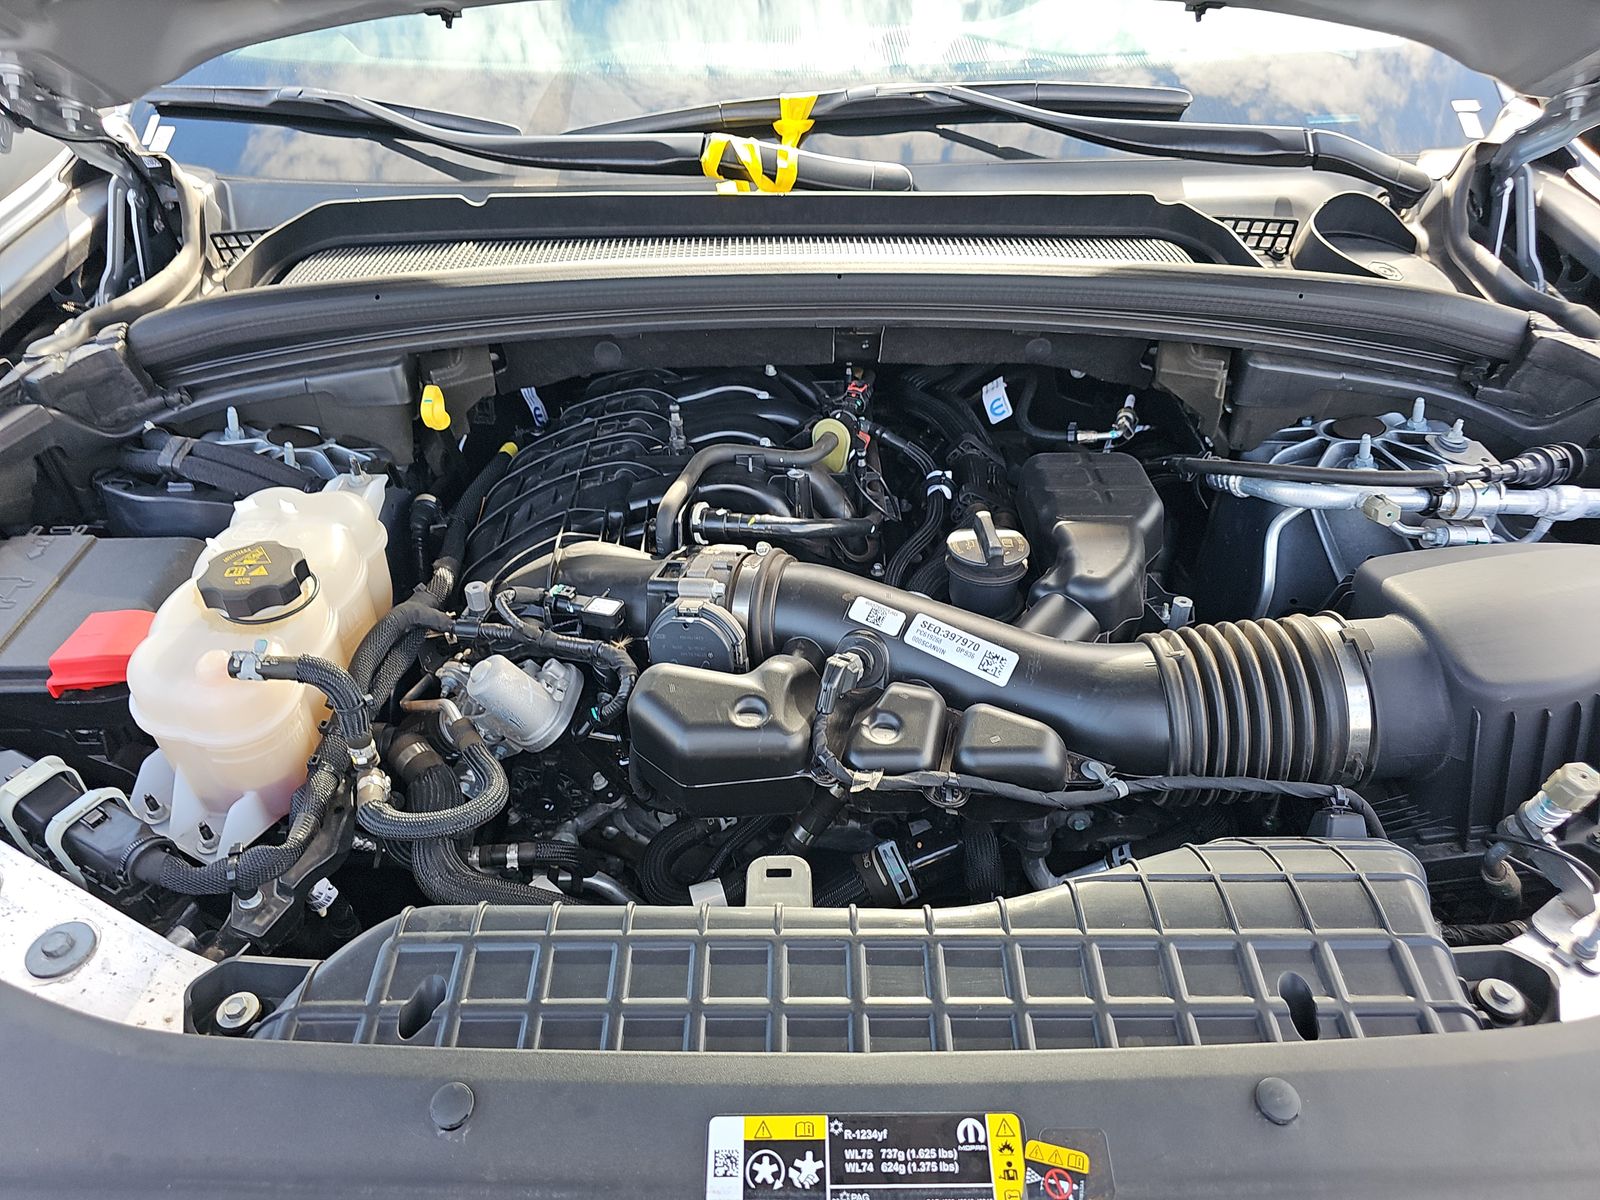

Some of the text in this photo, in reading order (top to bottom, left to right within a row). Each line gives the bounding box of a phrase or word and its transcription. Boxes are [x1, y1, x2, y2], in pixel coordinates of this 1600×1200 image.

[920, 620, 981, 652] SEQ:397970
[844, 1129, 888, 1141] R-1234yf
[844, 1148, 958, 1161] WL75 737g (1.625 lbs)
[844, 1161, 960, 1174] WL74 624g (1.375 lbs)
